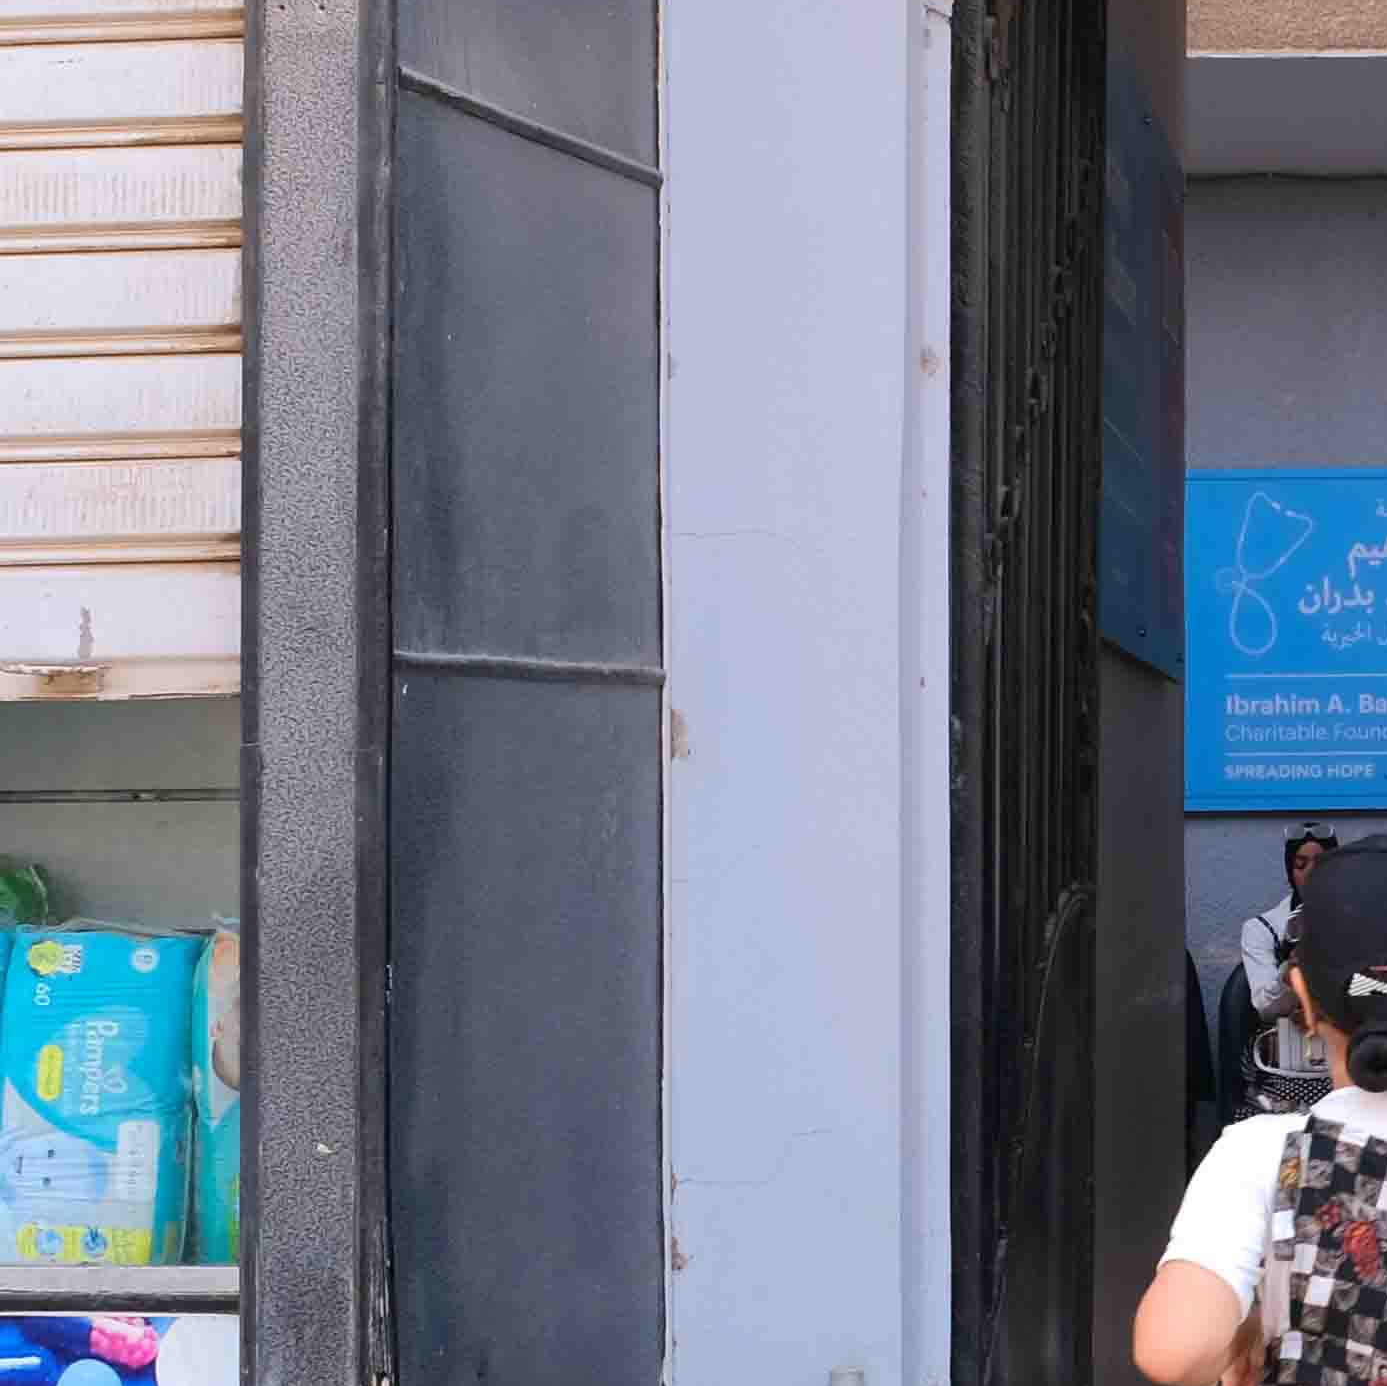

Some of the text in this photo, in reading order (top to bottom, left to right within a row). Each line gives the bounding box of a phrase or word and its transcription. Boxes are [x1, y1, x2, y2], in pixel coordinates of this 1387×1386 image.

[1297, 574, 1377, 616] بدران
[1320, 618, 1373, 651] الخيرية
[1224, 693, 1321, 715] Ibrahim
[1327, 693, 1351, 714] A.
[1224, 722, 1329, 742] Charitable
[1224, 763, 1377, 781] SPREADING HOPE
[79, 1019, 121, 1115] Pampers
